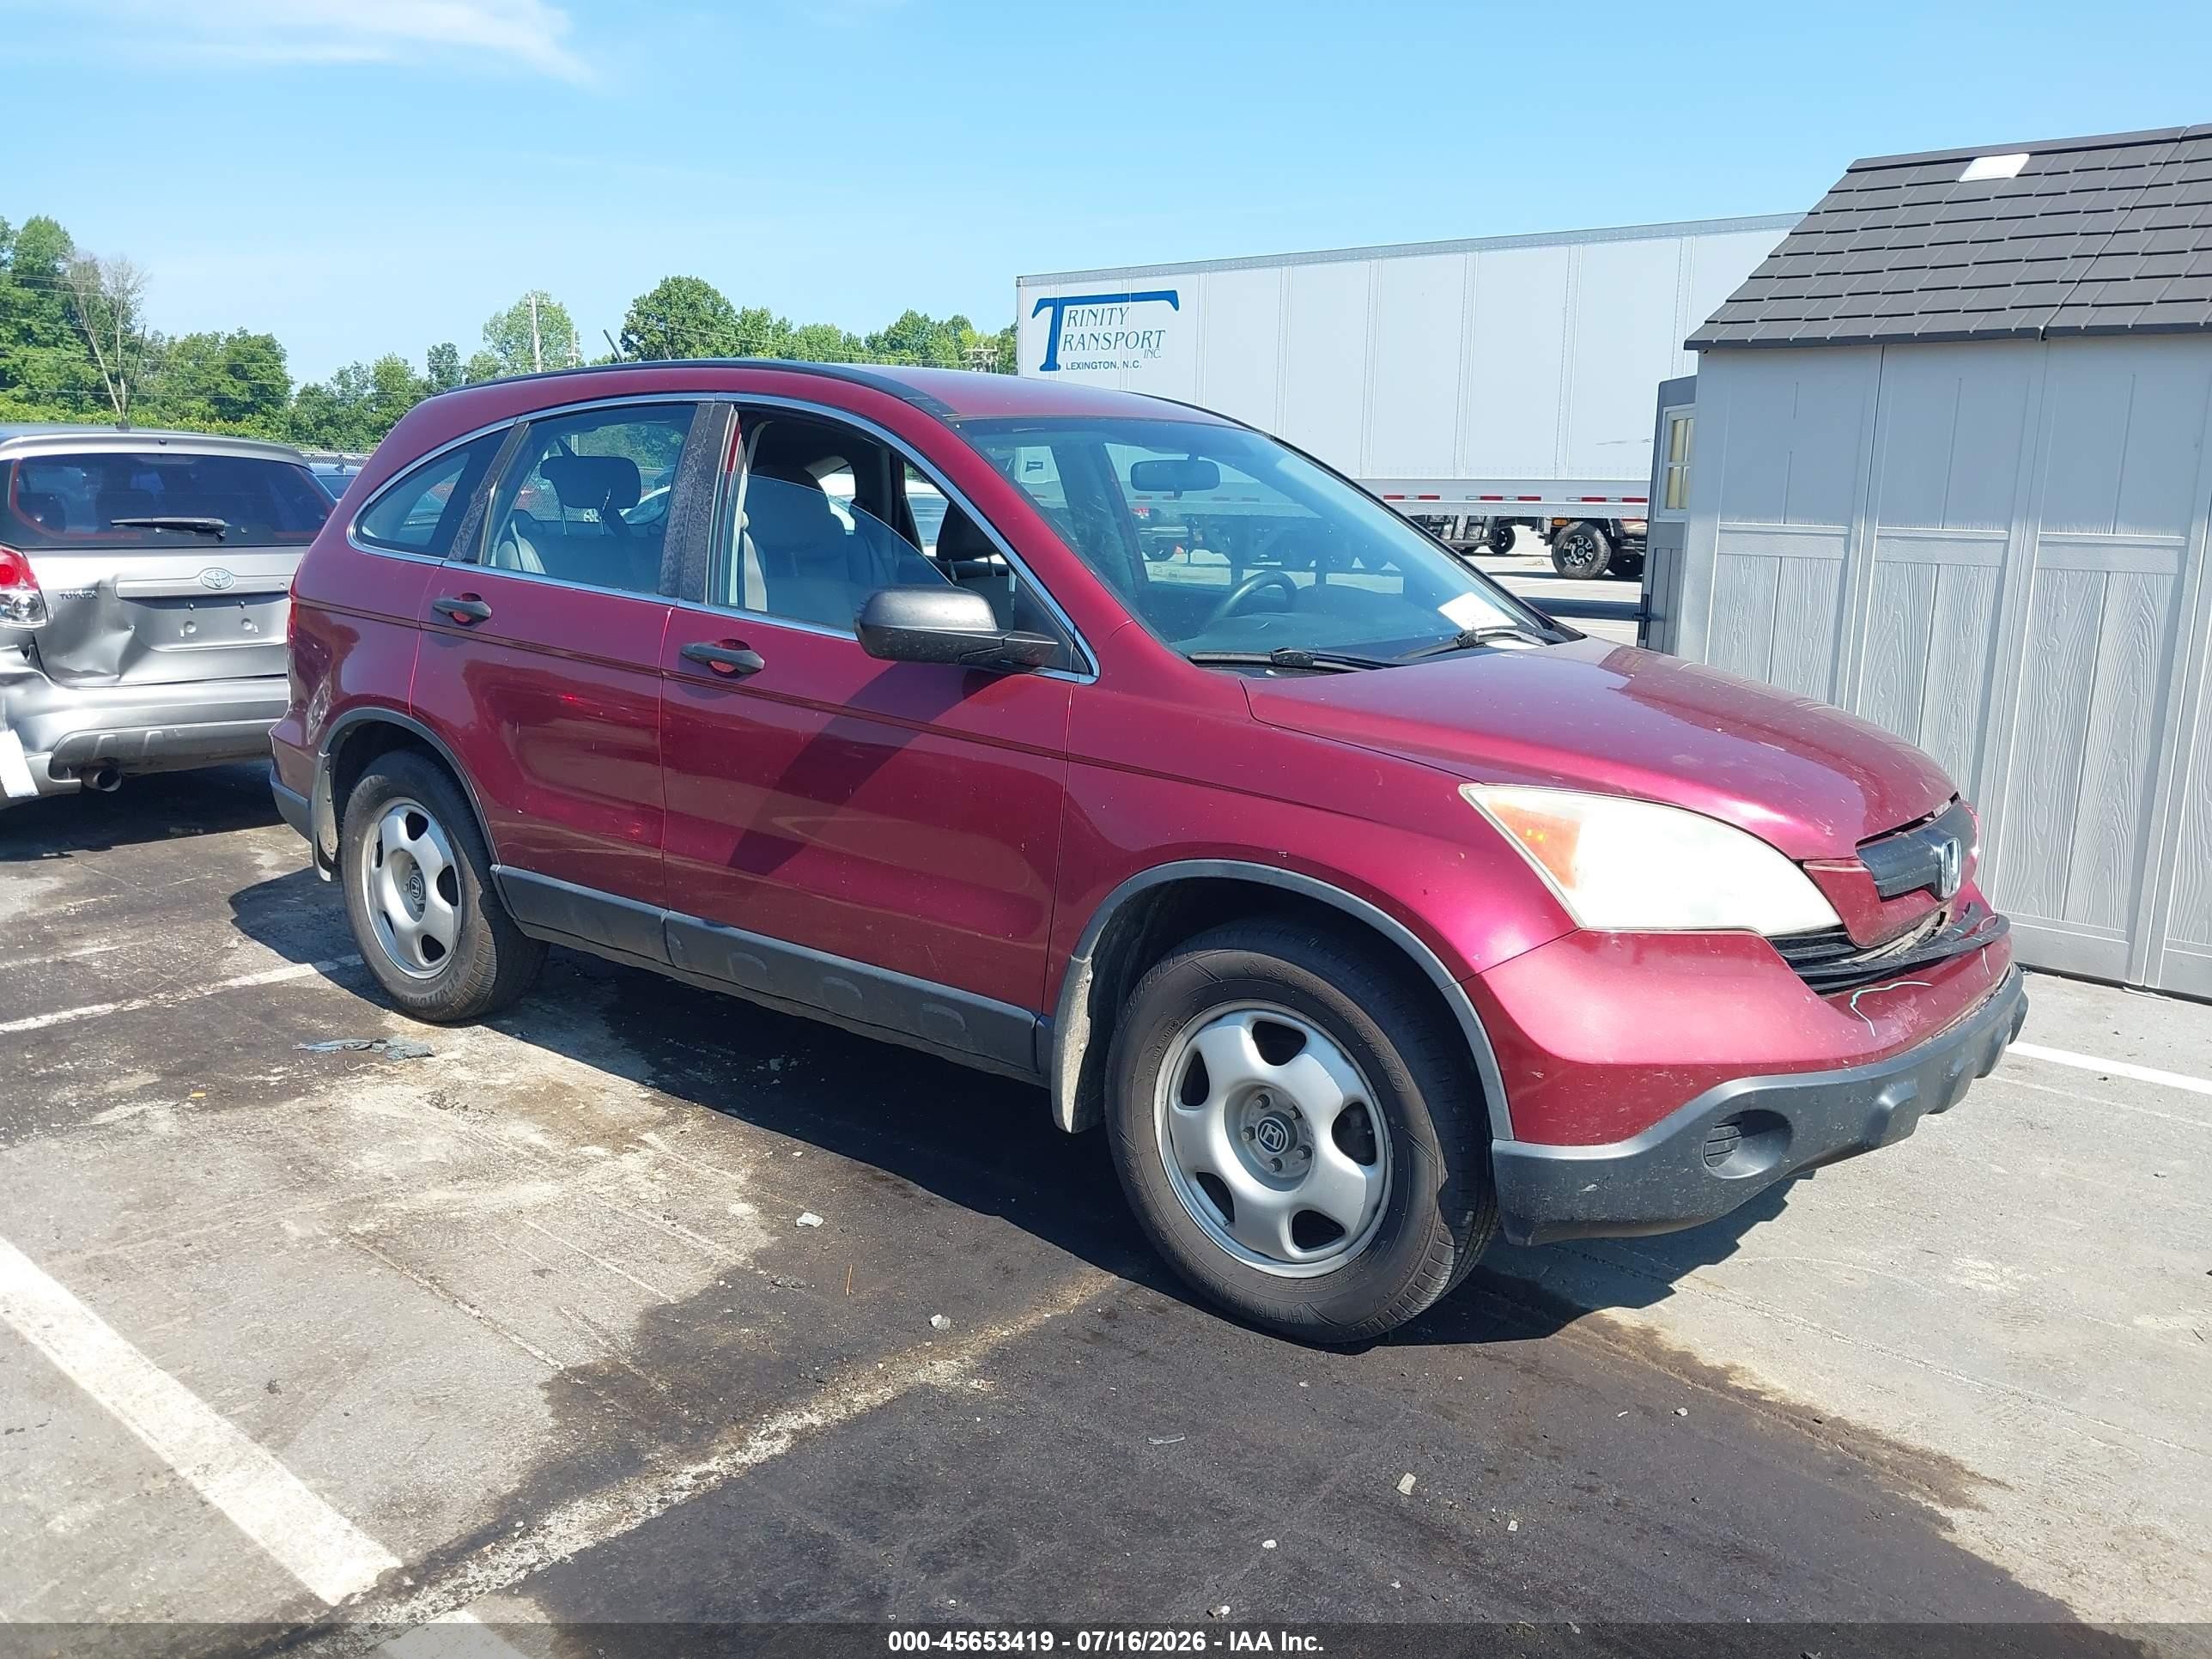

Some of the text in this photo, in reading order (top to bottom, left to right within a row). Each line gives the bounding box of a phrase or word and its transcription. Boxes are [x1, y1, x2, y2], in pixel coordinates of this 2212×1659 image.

[1143, 348, 1162, 359] INC.
[1066, 360, 1142, 371] LEXINGTON, N.C.
[58, 589, 99, 600] TOYOTA
[1251, 1297, 1305, 1325] HTR
